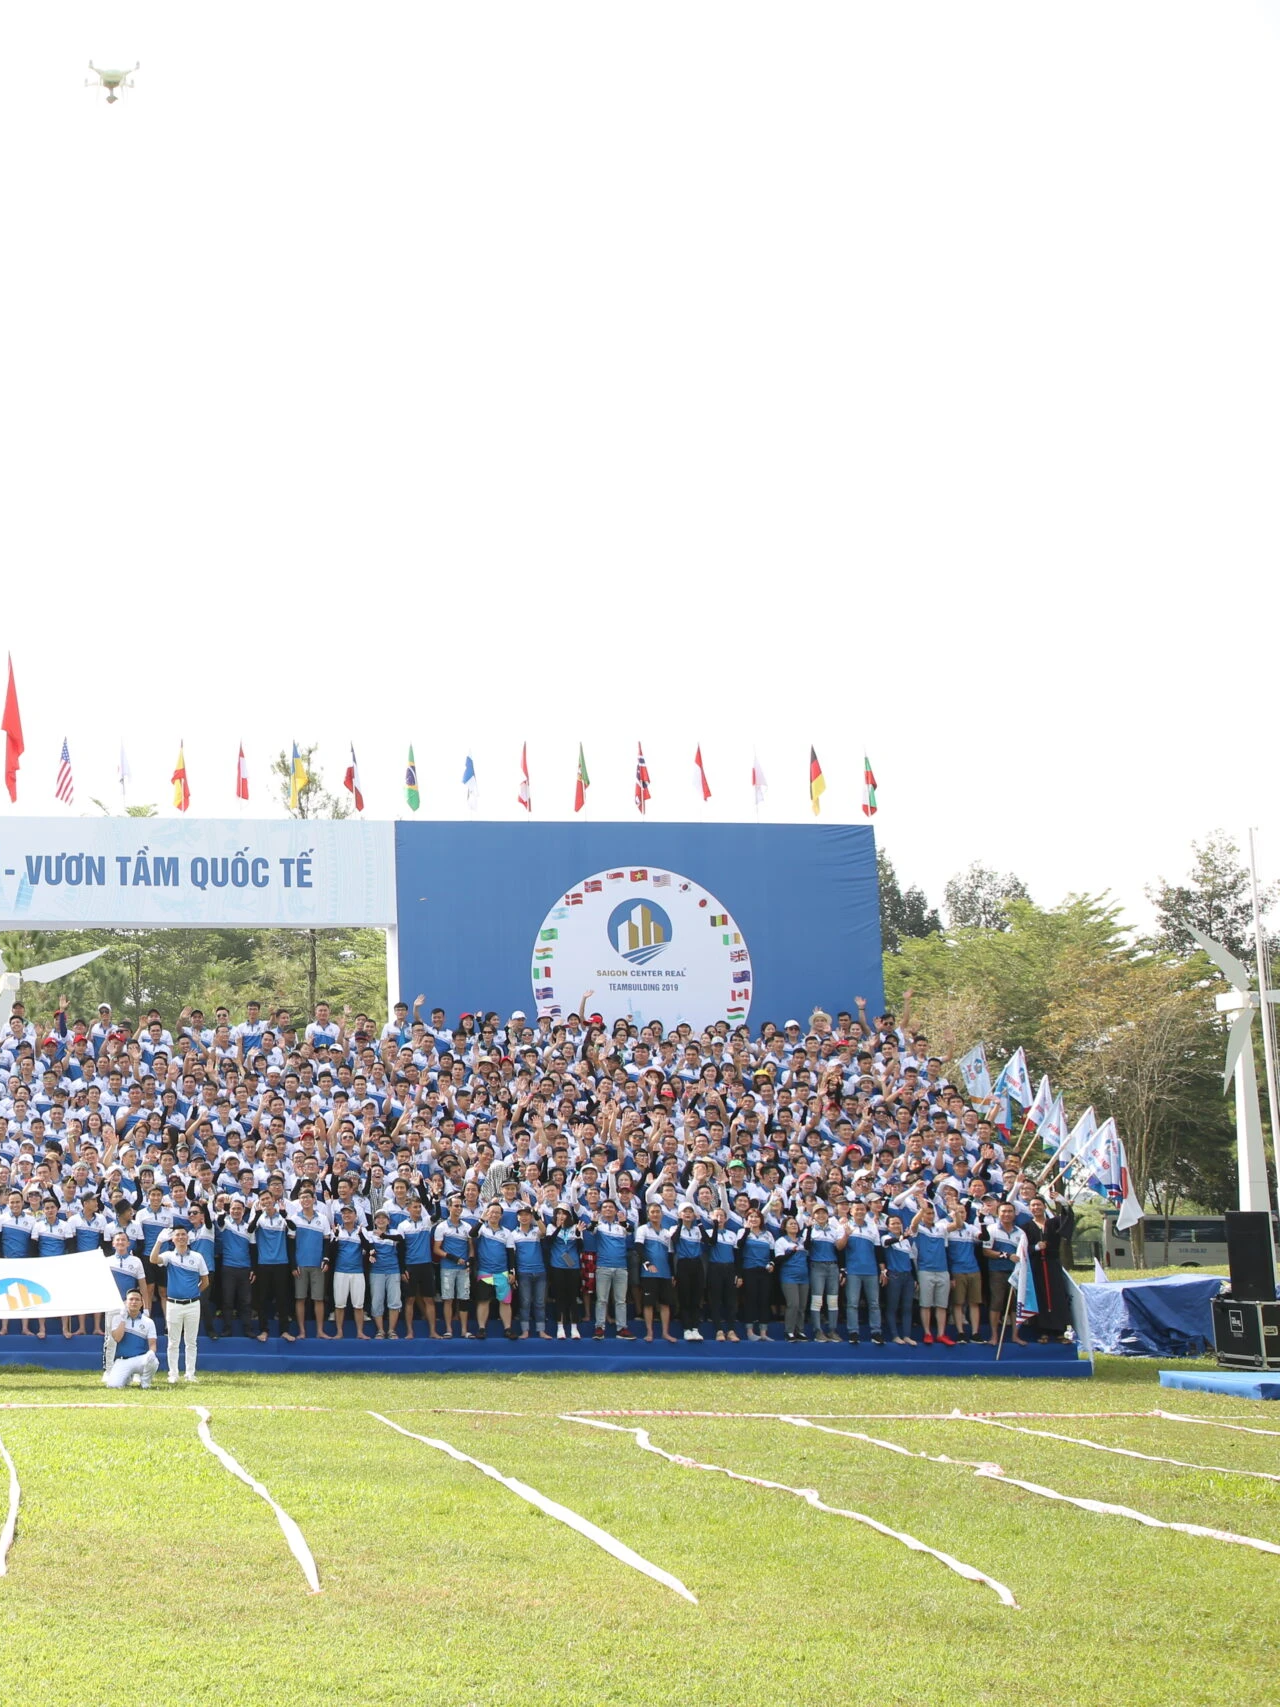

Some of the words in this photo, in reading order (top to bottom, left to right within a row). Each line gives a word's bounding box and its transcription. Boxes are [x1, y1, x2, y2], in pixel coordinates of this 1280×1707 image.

[25, 852, 106, 886] VƯƠN
[116, 845, 180, 887] TẦM
[190, 846, 270, 891] QUỐC
[279, 848, 314, 888] TẾ
[609, 983, 660, 991] TEAMBUILDING
[661, 983, 679, 991] 2019
